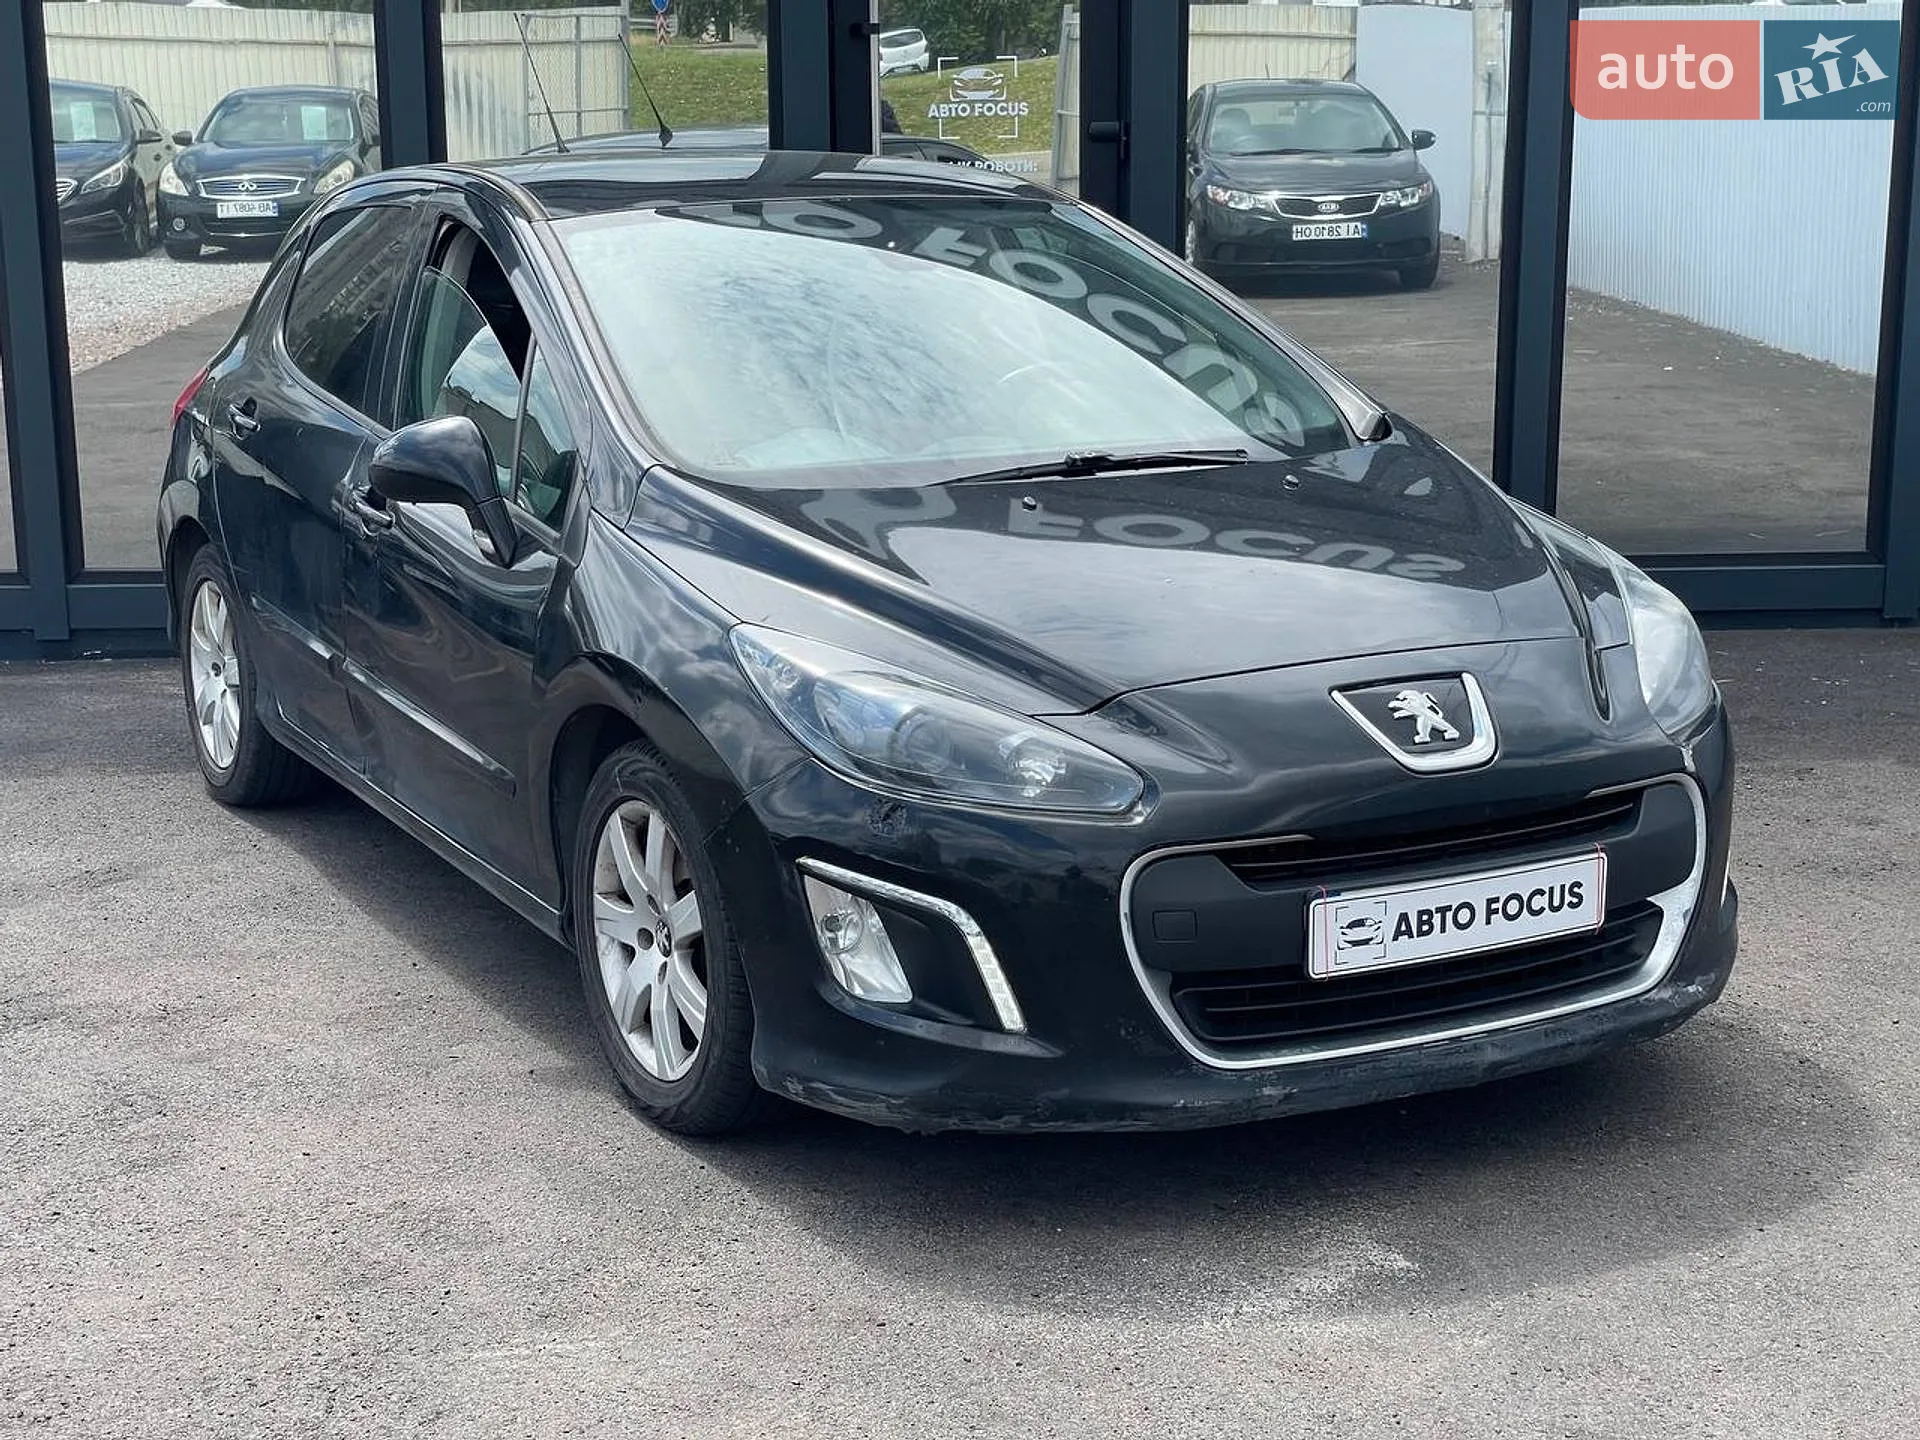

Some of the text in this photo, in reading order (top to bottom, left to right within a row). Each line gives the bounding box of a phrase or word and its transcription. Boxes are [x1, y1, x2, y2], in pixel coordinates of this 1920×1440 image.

[928, 102, 1029, 118] АВТО FOCUS
[1392, 881, 1585, 942] АВТО FOCUS
